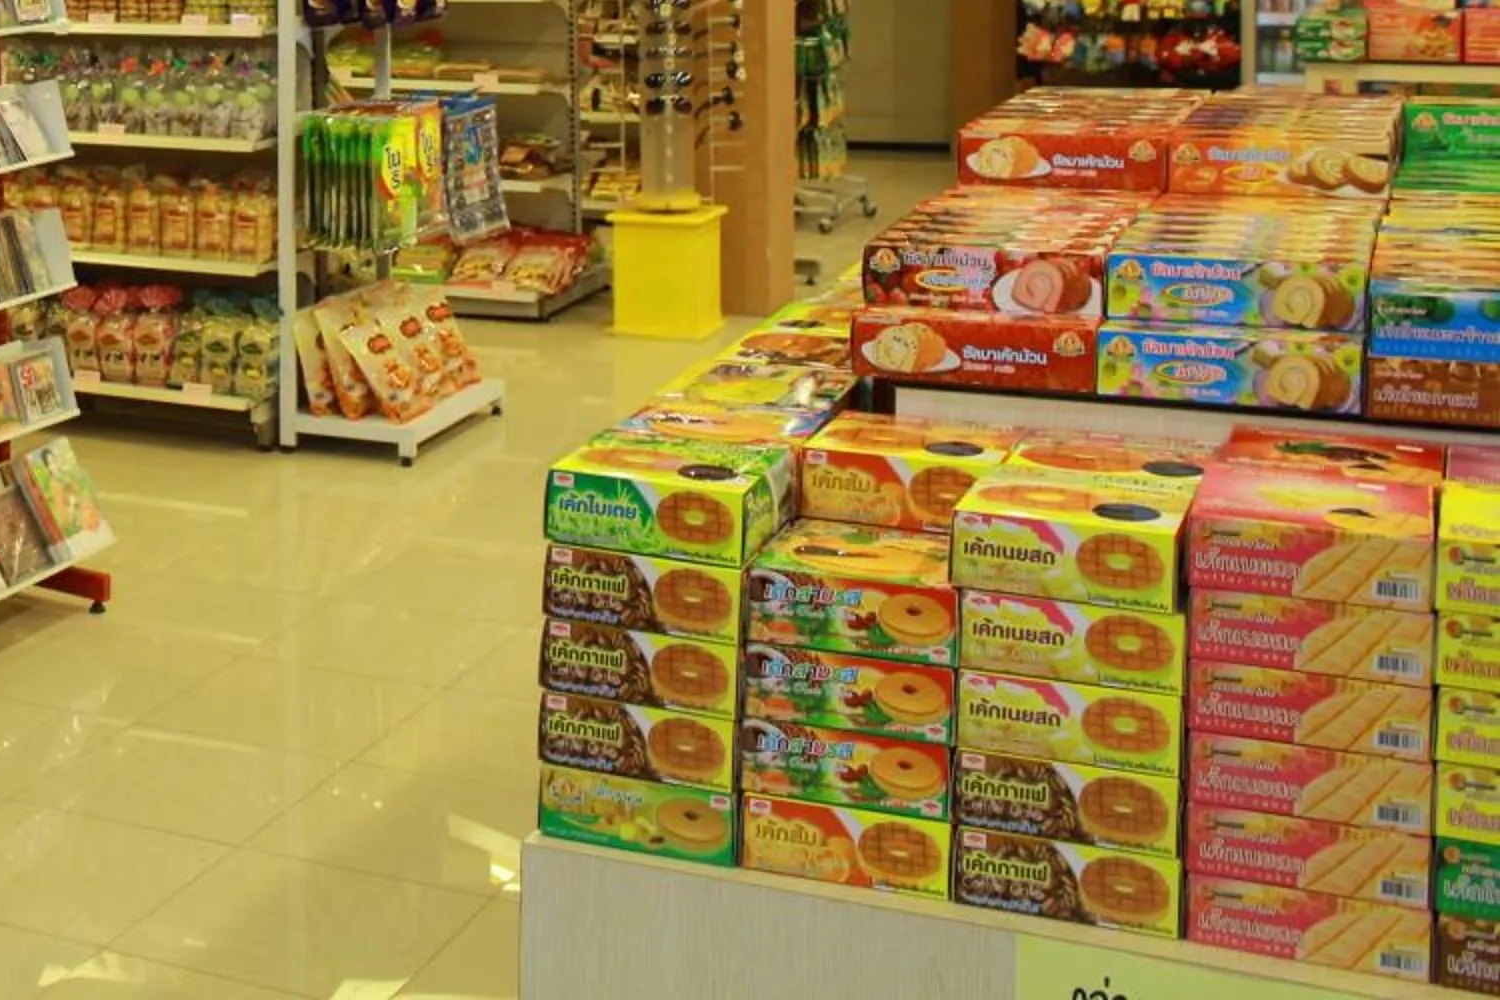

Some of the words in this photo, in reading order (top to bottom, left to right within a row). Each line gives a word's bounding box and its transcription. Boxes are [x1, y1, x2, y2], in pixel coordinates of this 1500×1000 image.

[811, 468, 871, 494] เค้กส้ม
[558, 492, 638, 521] เค้กใบเตย
[962, 536, 1056, 566] เค้กเนยสด
[552, 568, 627, 595] เค้กกาแฟ
[971, 617, 1065, 647] เค้กเนยสด
[550, 641, 624, 669] เค้กกาแฟ
[968, 698, 1061, 727] เค้กเนยสด
[547, 714, 621, 742] เค้กกาแฟ
[963, 778, 1048, 803] เค้กกาแฟ
[755, 820, 817, 846] เค้กส้ม
[963, 855, 1048, 882] เค้กกาแฟ
